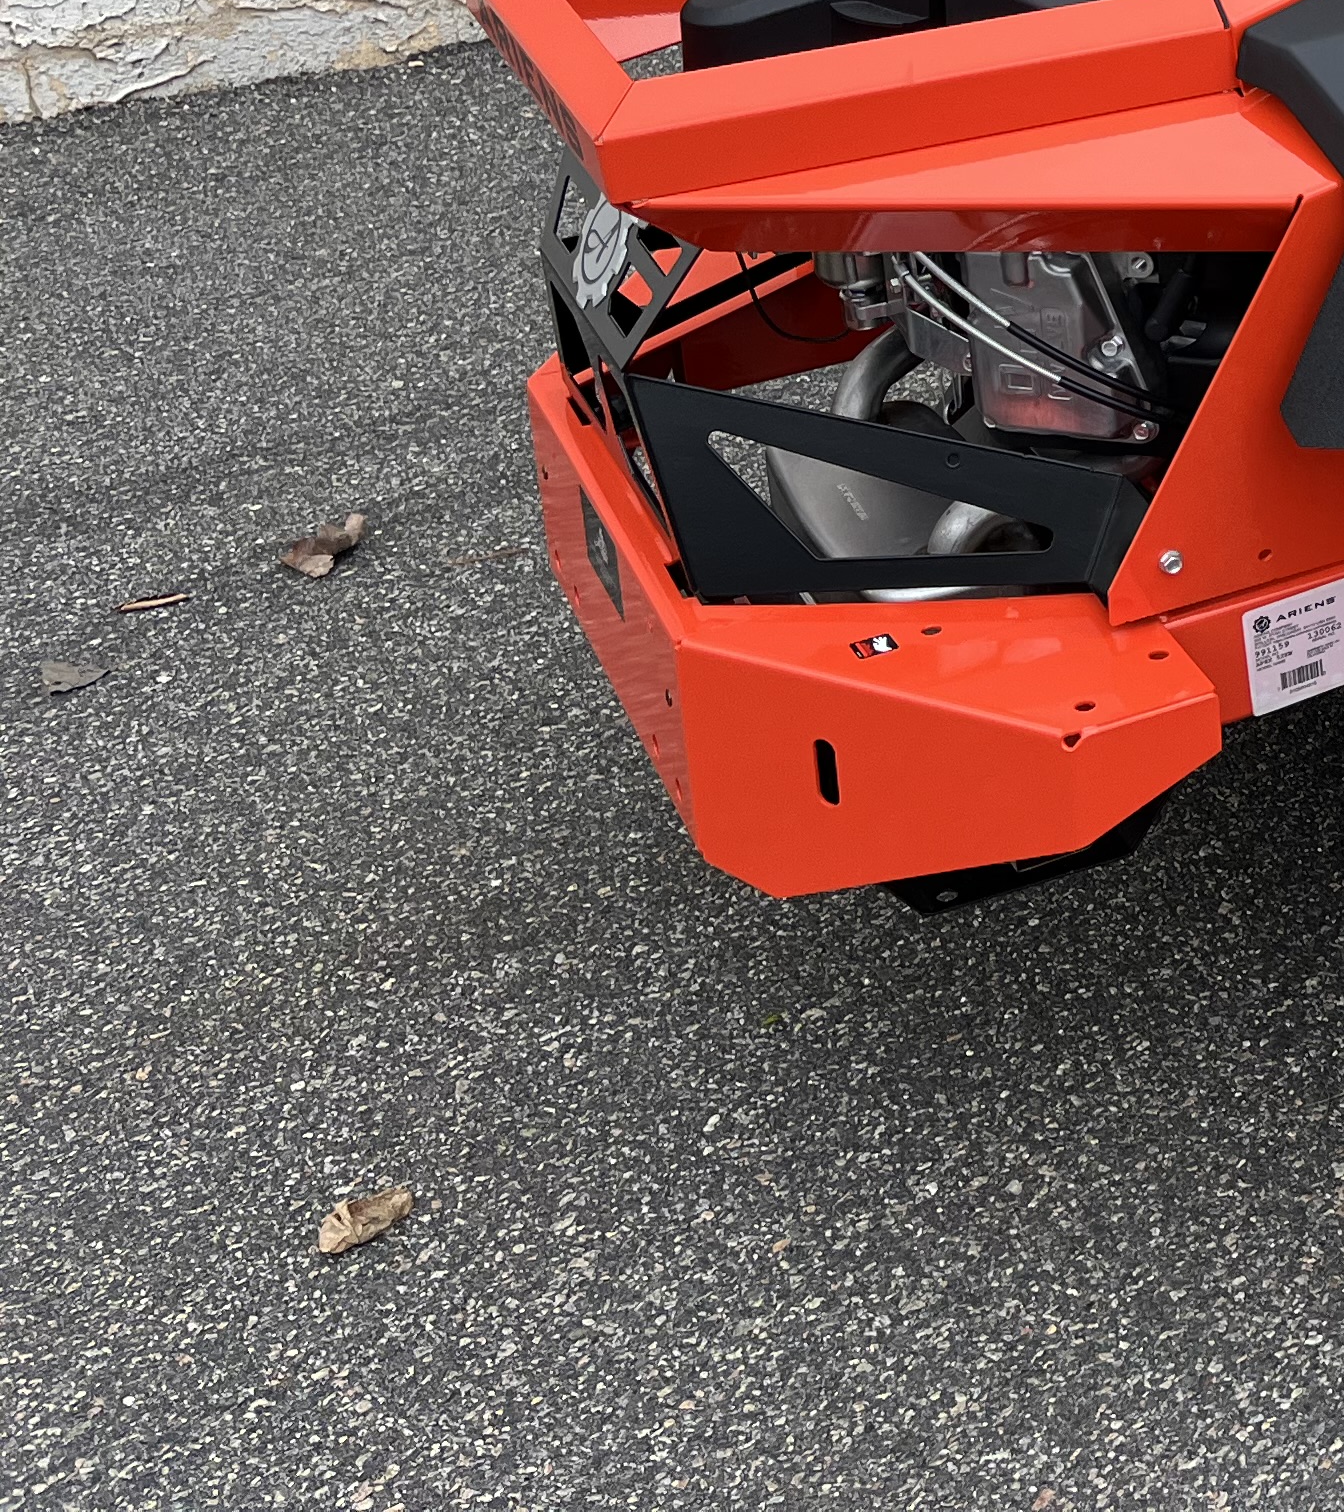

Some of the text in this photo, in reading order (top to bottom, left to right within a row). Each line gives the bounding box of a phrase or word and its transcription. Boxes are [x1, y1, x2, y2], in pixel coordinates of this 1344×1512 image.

[1276, 596, 1336, 623] ARIENS
[1307, 622, 1342, 640] 130062
[1255, 641, 1290, 658] 991159
